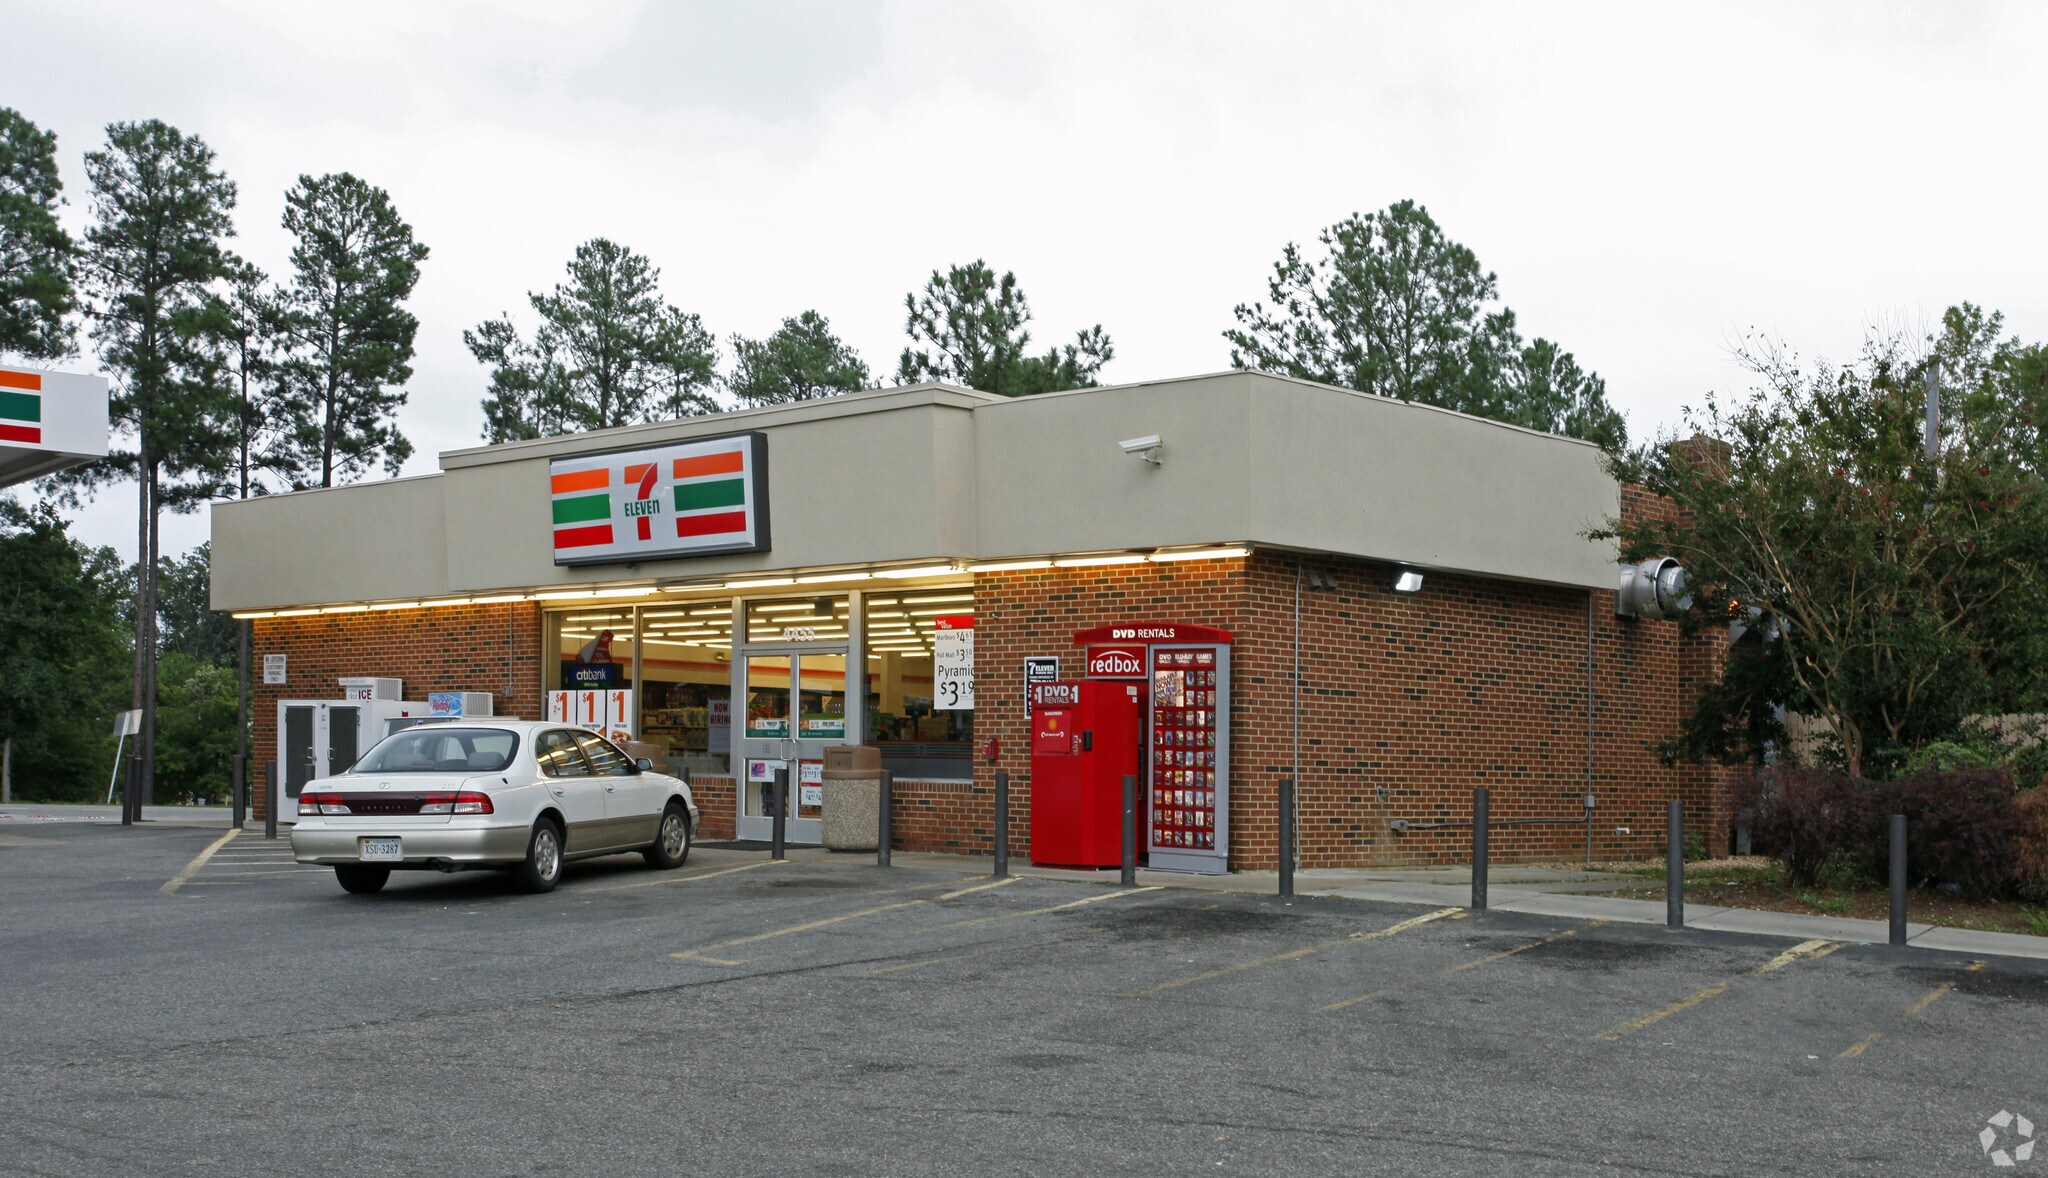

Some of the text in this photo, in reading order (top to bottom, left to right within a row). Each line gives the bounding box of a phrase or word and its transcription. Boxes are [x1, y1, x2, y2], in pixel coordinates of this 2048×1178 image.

[624, 462, 658, 541] 7
[783, 626, 816, 642] 4455
[1112, 628, 1175, 639] DVD RENTALS
[1028, 662, 1036, 675] 7
[1090, 655, 1140, 673] redbox
[576, 668, 607, 681] citibank
[358, 689, 373, 700] ICE
[1034, 686, 1043, 704] $1
[1044, 685, 1069, 697] DVD
[1070, 685, 1079, 704] $1
[1044, 696, 1070, 704] RENTALS
[555, 692, 568, 723] $1
[582, 692, 595, 723] $1
[612, 691, 625, 723] $1
[713, 702, 729, 713] NOW
[365, 844, 399, 855] XSU-3287
